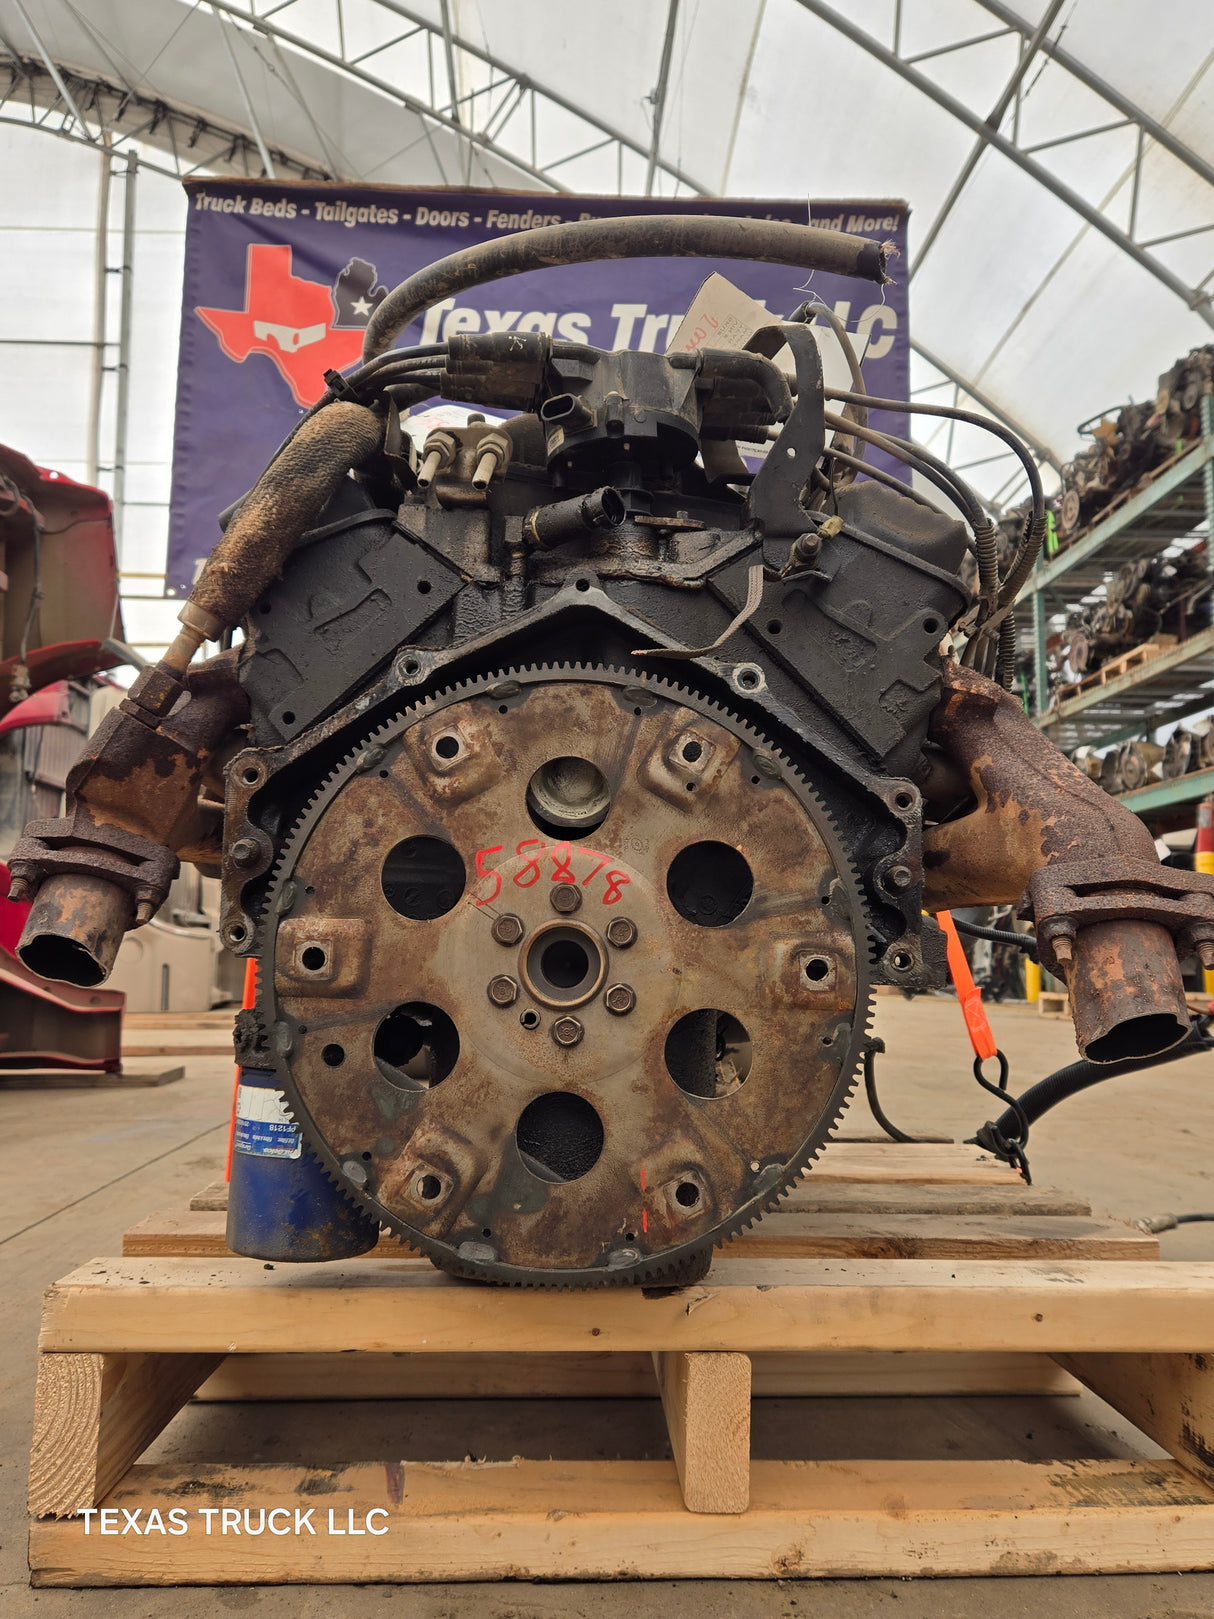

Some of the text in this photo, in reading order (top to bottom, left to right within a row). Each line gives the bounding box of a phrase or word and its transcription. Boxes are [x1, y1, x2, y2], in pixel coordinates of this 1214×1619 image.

[196, 192, 247, 214] Truck
[249, 198, 297, 219] Beds
[315, 201, 399, 227] Tailgates
[415, 206, 470, 228] Doors
[486, 210, 562, 229] Fenders
[846, 214, 899, 233] More!
[475, 839, 631, 906] 58878
